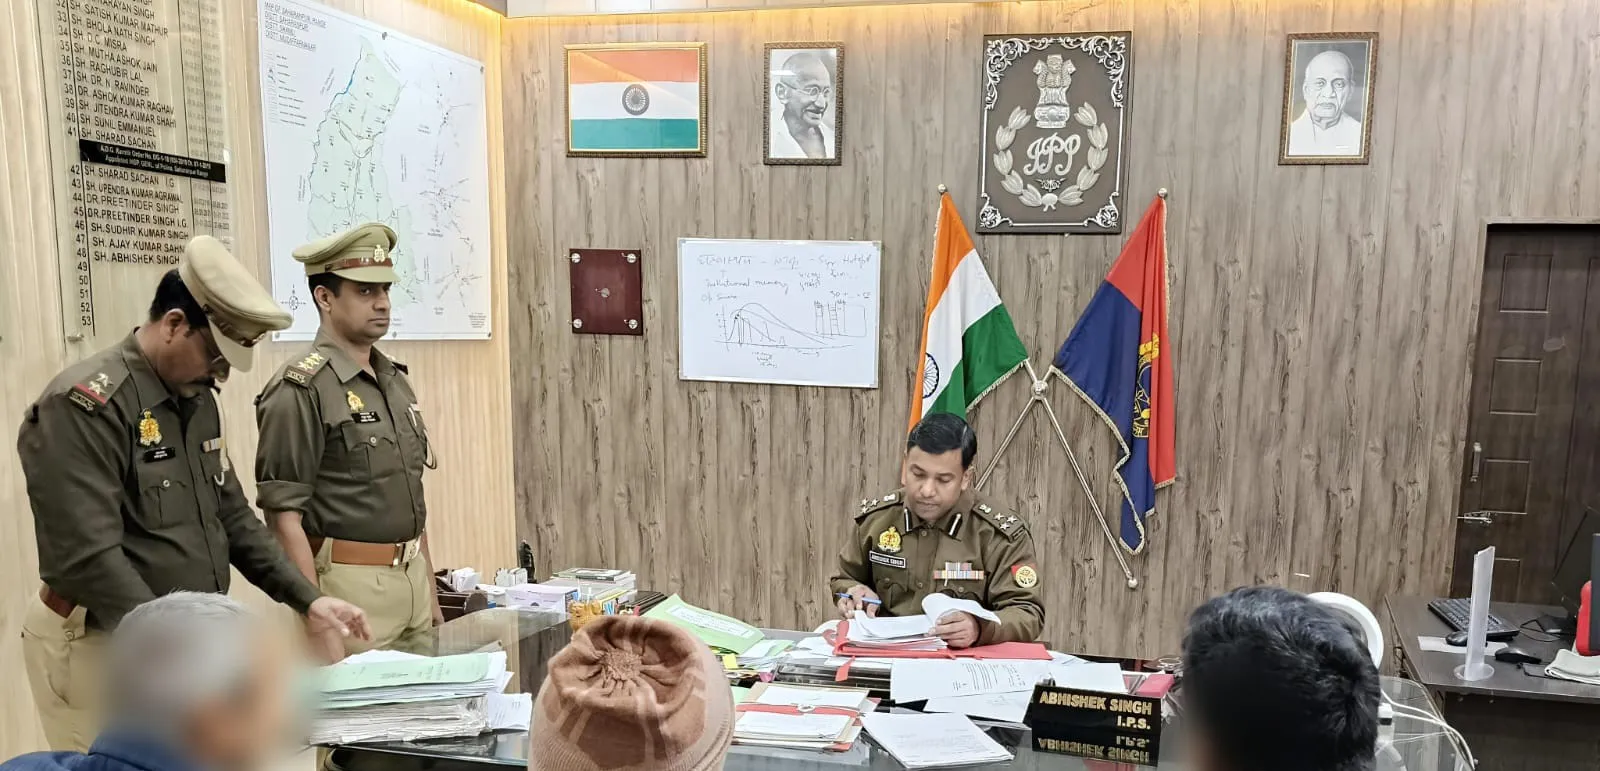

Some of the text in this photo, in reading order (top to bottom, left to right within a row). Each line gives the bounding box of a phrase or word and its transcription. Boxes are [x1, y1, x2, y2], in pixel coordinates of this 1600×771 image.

[84, 4, 112, 20] SATISH
[113, 13, 139, 28] KUMAR
[140, 21, 168, 39] MATHUR
[133, 5, 155, 20] SINGH
[57, 10, 67, 22] 33
[86, 18, 112, 34] BHOLA
[113, 25, 132, 40] NATH
[134, 31, 156, 47] SINGH
[59, 25, 68, 35] 34
[104, 36, 127, 52] MISRA
[61, 40, 71, 51] 35
[88, 46, 114, 61] MUTHA
[114, 54, 142, 69] ASHOK
[143, 60, 158, 73] JAIN
[61, 54, 71, 65] 36
[89, 61, 129, 78] RAGHUBIR
[130, 71, 143, 83] LAL
[63, 68, 72, 79] 37
[114, 80, 150, 97] RAVINDER
[64, 83, 74, 94] 38
[93, 89, 118, 104] ASHOK
[120, 93, 146, 109] KUMAR
[147, 99, 175, 115] RAGHAV
[65, 97, 75, 109] 39
[93, 103, 128, 120] JITENDRA
[130, 109, 156, 123] KUMAR
[157, 115, 176, 128] SHAHI
[66, 112, 76, 123] 40
[95, 117, 116, 130] SUNIL
[117, 120, 157, 138] EMMANUEL
[67, 126, 77, 137] 41
[95, 131, 126, 145] SHARAD
[127, 134, 156, 150] SACHAN
[70, 164, 80, 175] 42
[98, 168, 129, 181] SHARAD
[131, 172, 159, 185] SACHAN
[71, 178, 81, 189] 43
[98, 183, 130, 196] UPENDRA
[131, 187, 153, 199] KUMAR
[154, 190, 184, 204] AGRAWAL
[72, 192, 82, 202] 44
[156, 202, 180, 214] SINGH
[73, 206, 84, 217] 45
[152, 214, 175, 227] SINGH
[74, 220, 85, 231] 46
[138, 227, 166, 239] KUMAR
[167, 230, 189, 240] SINGH
[75, 234, 86, 245] 47
[109, 238, 130, 249] AJAY
[133, 240, 162, 252] KUMAR
[76, 248, 87, 258] 48
[111, 252, 154, 265] ABHISHEK
[156, 254, 180, 265] SINGH
[77, 261, 88, 271] 49
[79, 275, 88, 285] 50
[79, 288, 89, 299] 51
[80, 302, 90, 313] 52
[82, 315, 92, 326] 53
[1039, 690, 1152, 716] ABHISHEK SINGH
[1117, 715, 1151, 730] I.P.S.
